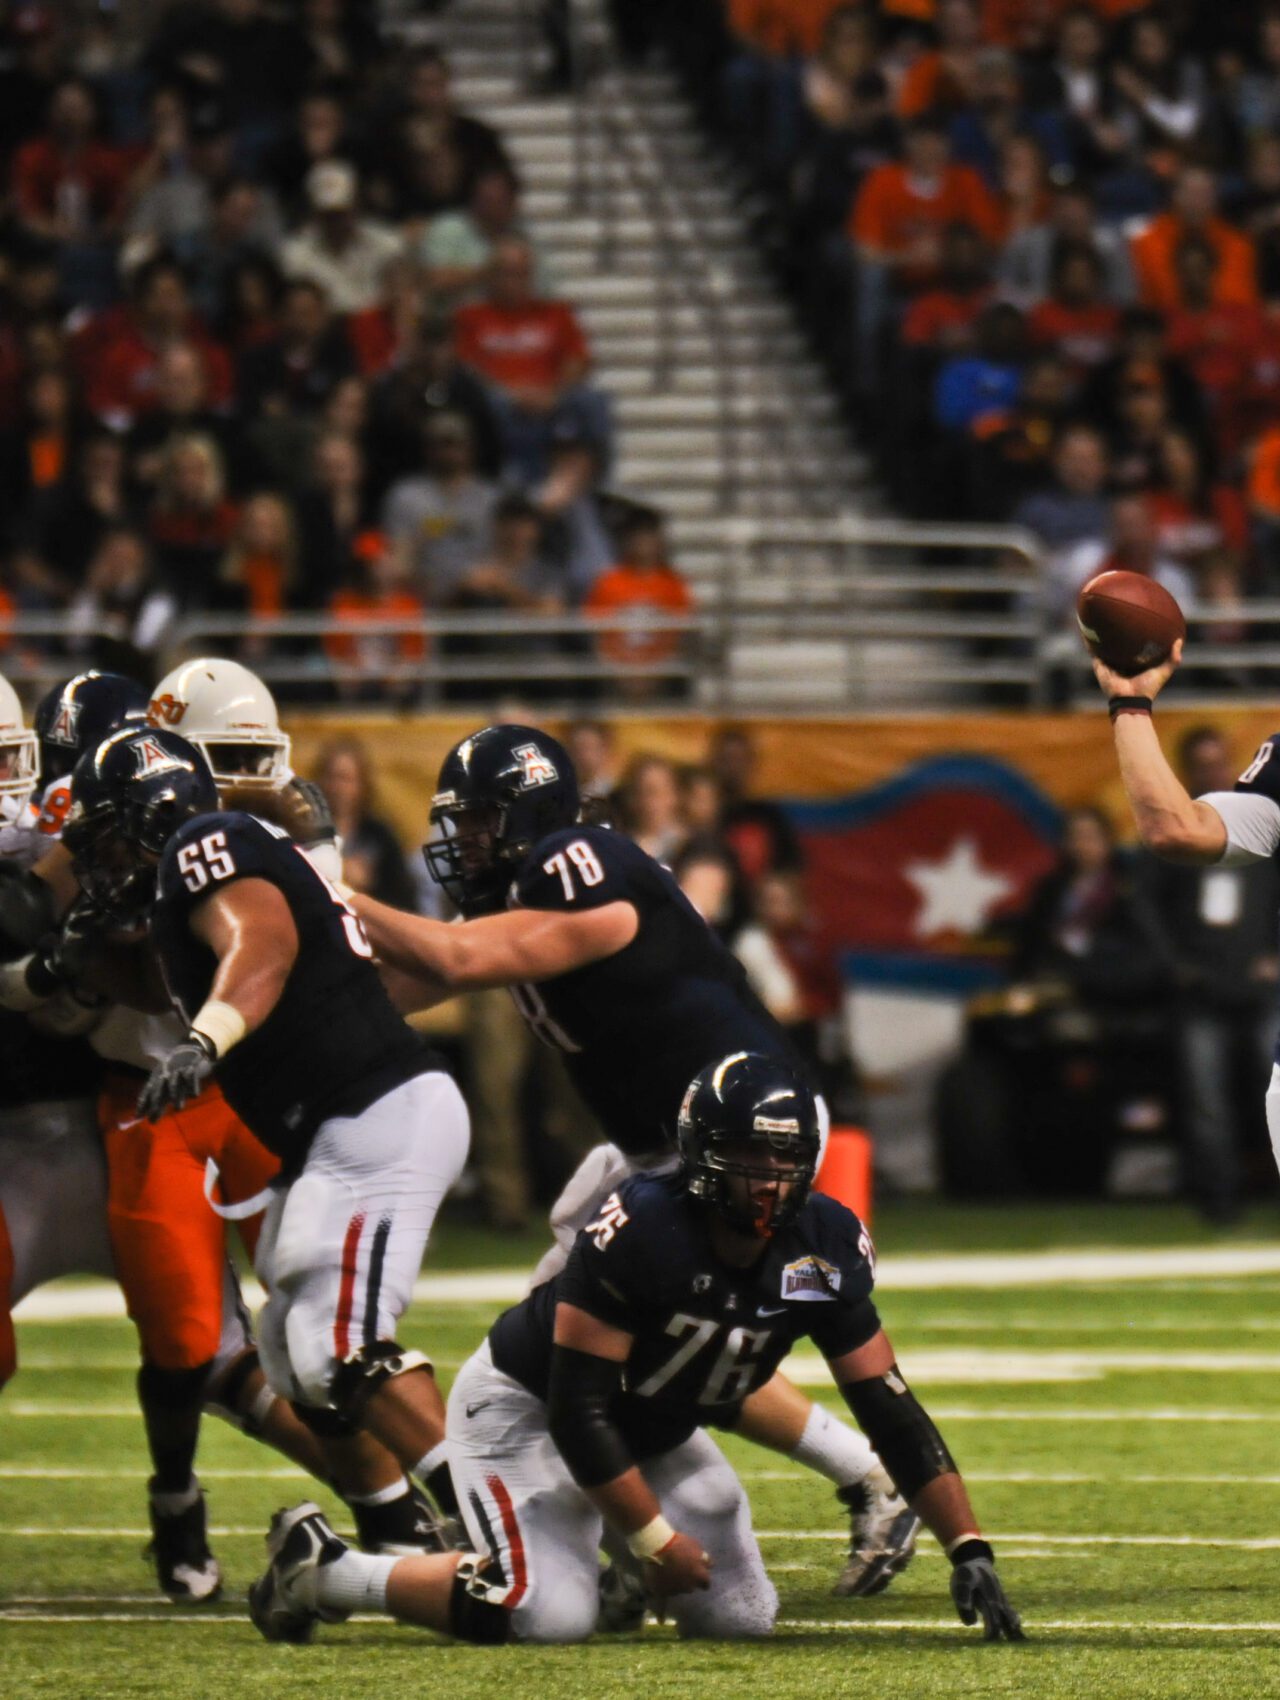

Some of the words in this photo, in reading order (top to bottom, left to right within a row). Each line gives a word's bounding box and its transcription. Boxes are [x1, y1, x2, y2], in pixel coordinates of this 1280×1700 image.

[511, 742, 559, 792] A
[1238, 742, 1274, 784] 8
[177, 831, 237, 893] 55
[543, 839, 605, 901] 78
[635, 1312, 773, 1406] 76
